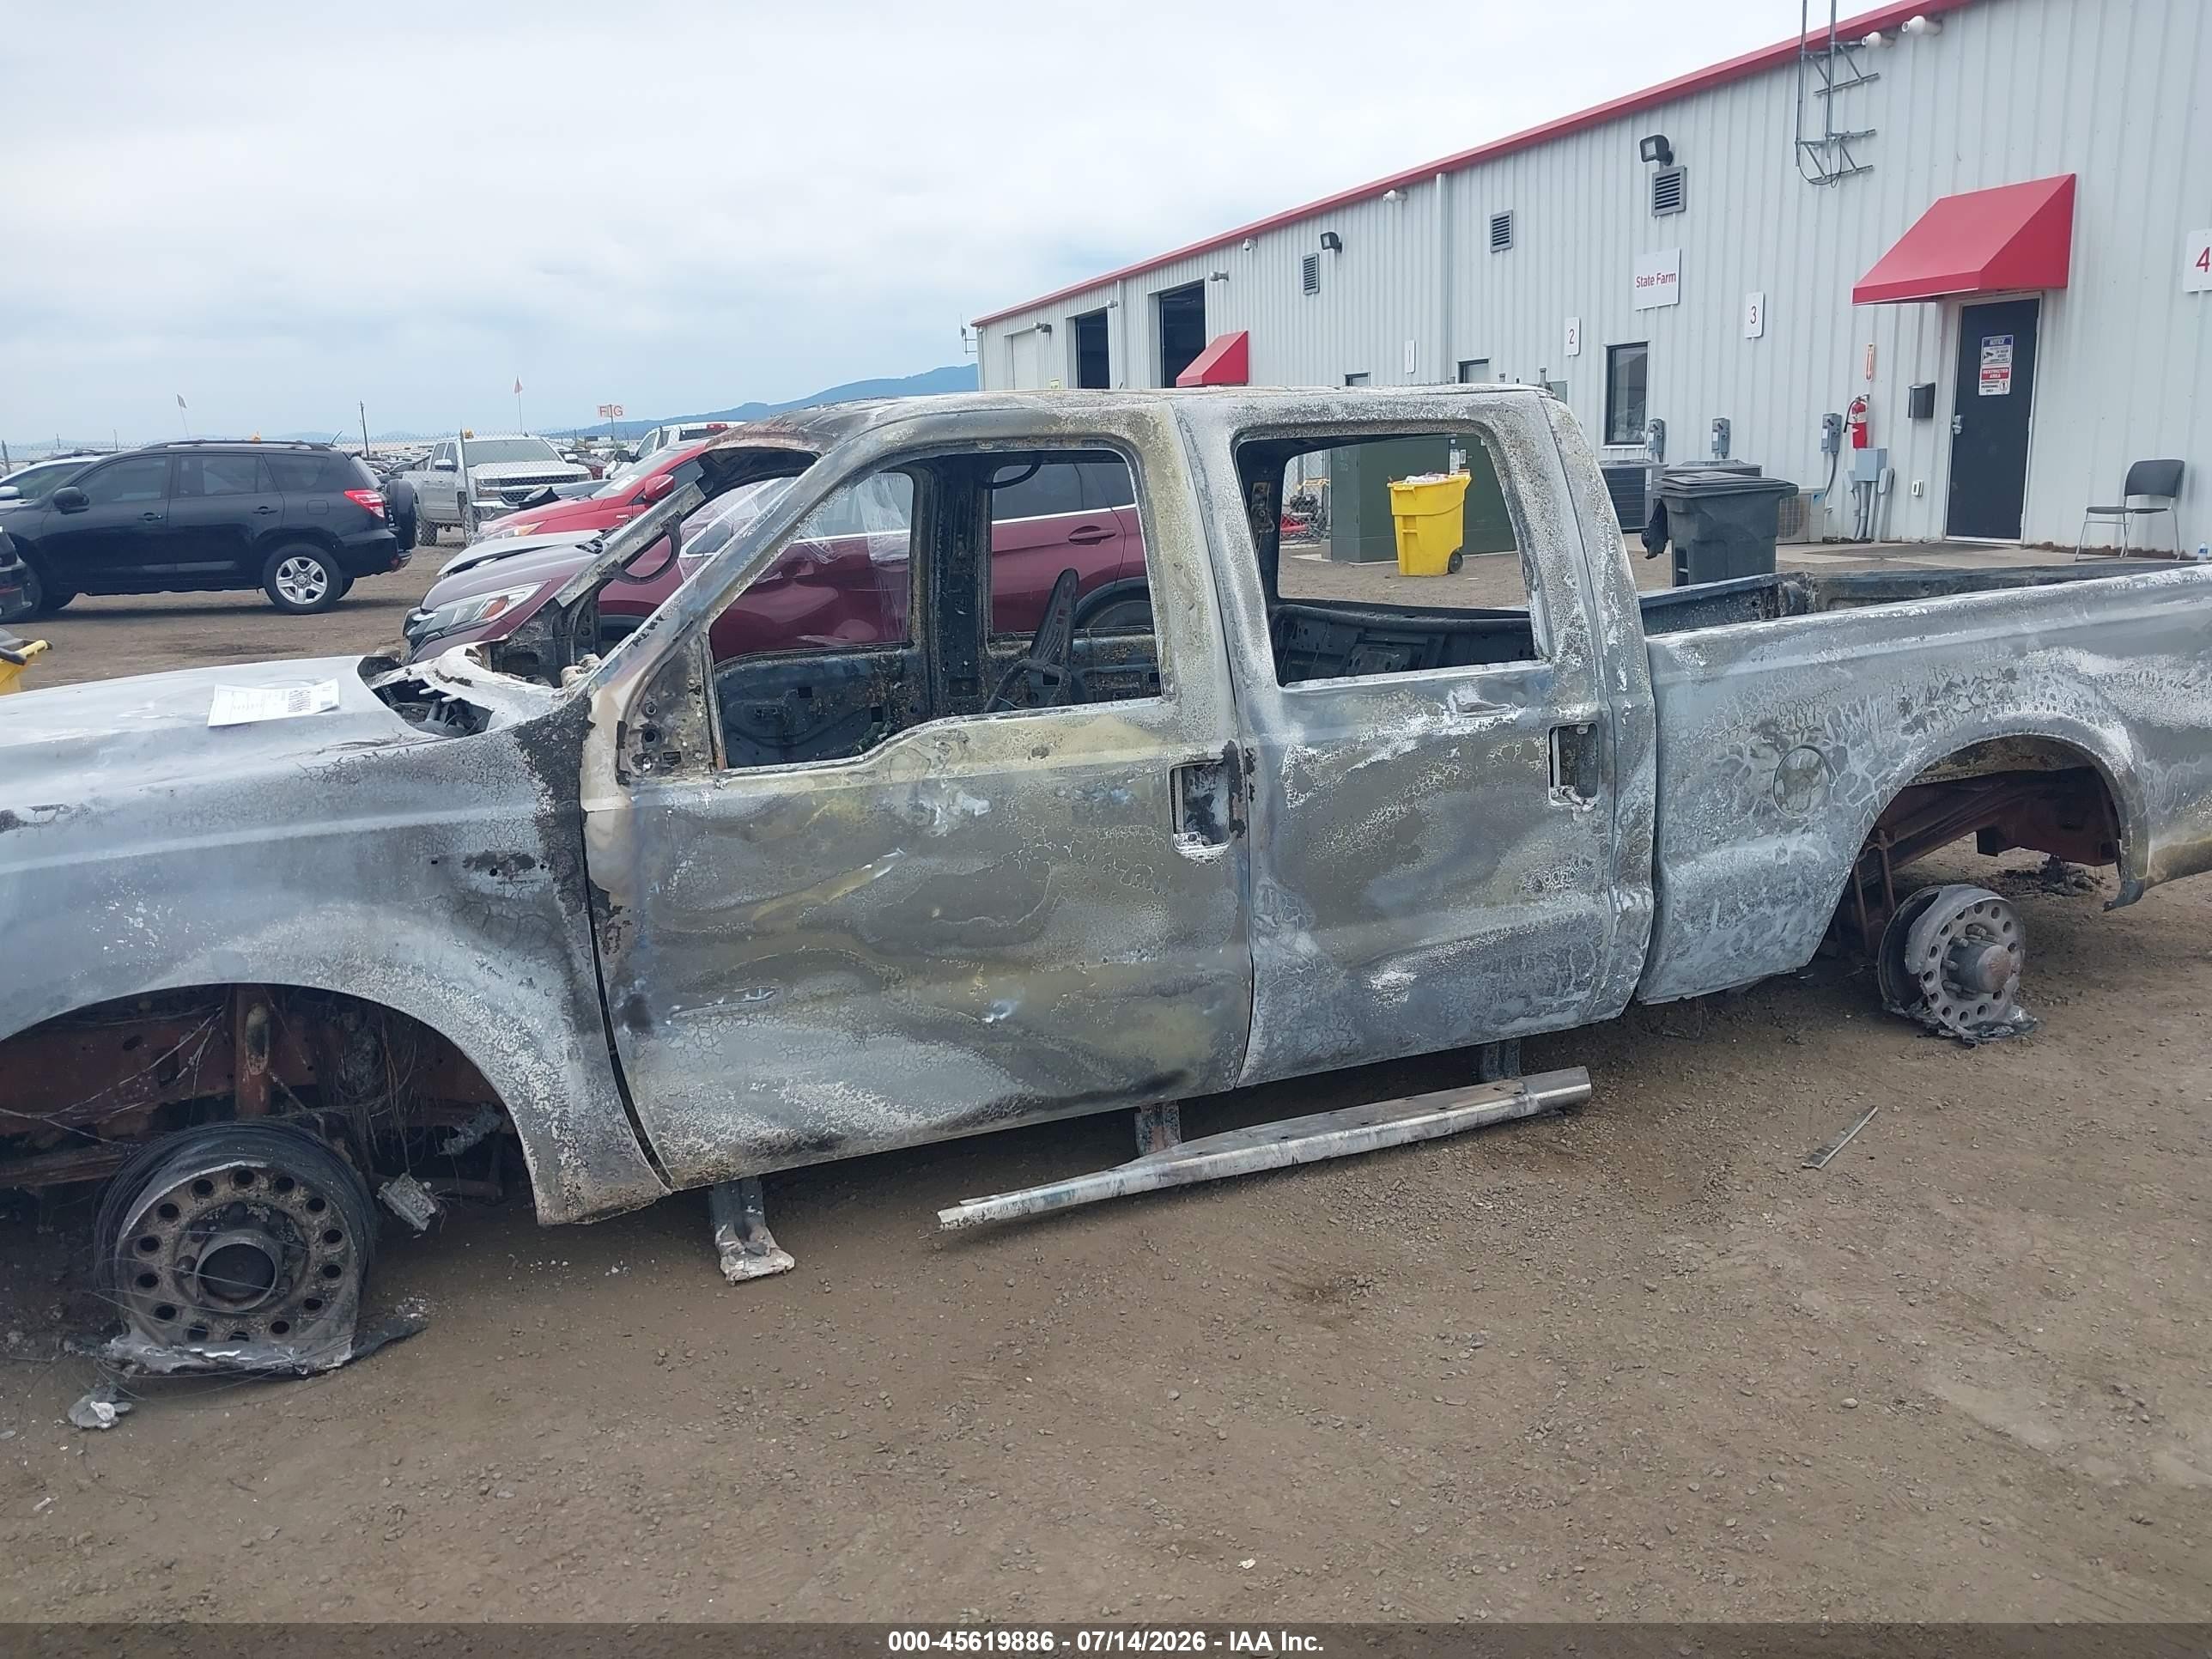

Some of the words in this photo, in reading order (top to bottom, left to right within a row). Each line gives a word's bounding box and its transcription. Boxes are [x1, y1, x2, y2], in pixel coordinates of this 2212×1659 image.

[2195, 246, 2210, 273] 4
[1636, 275, 1656, 289] State
[1656, 271, 1677, 286] Farm
[1750, 305, 1757, 325] 3
[1569, 328, 1575, 344] 2
